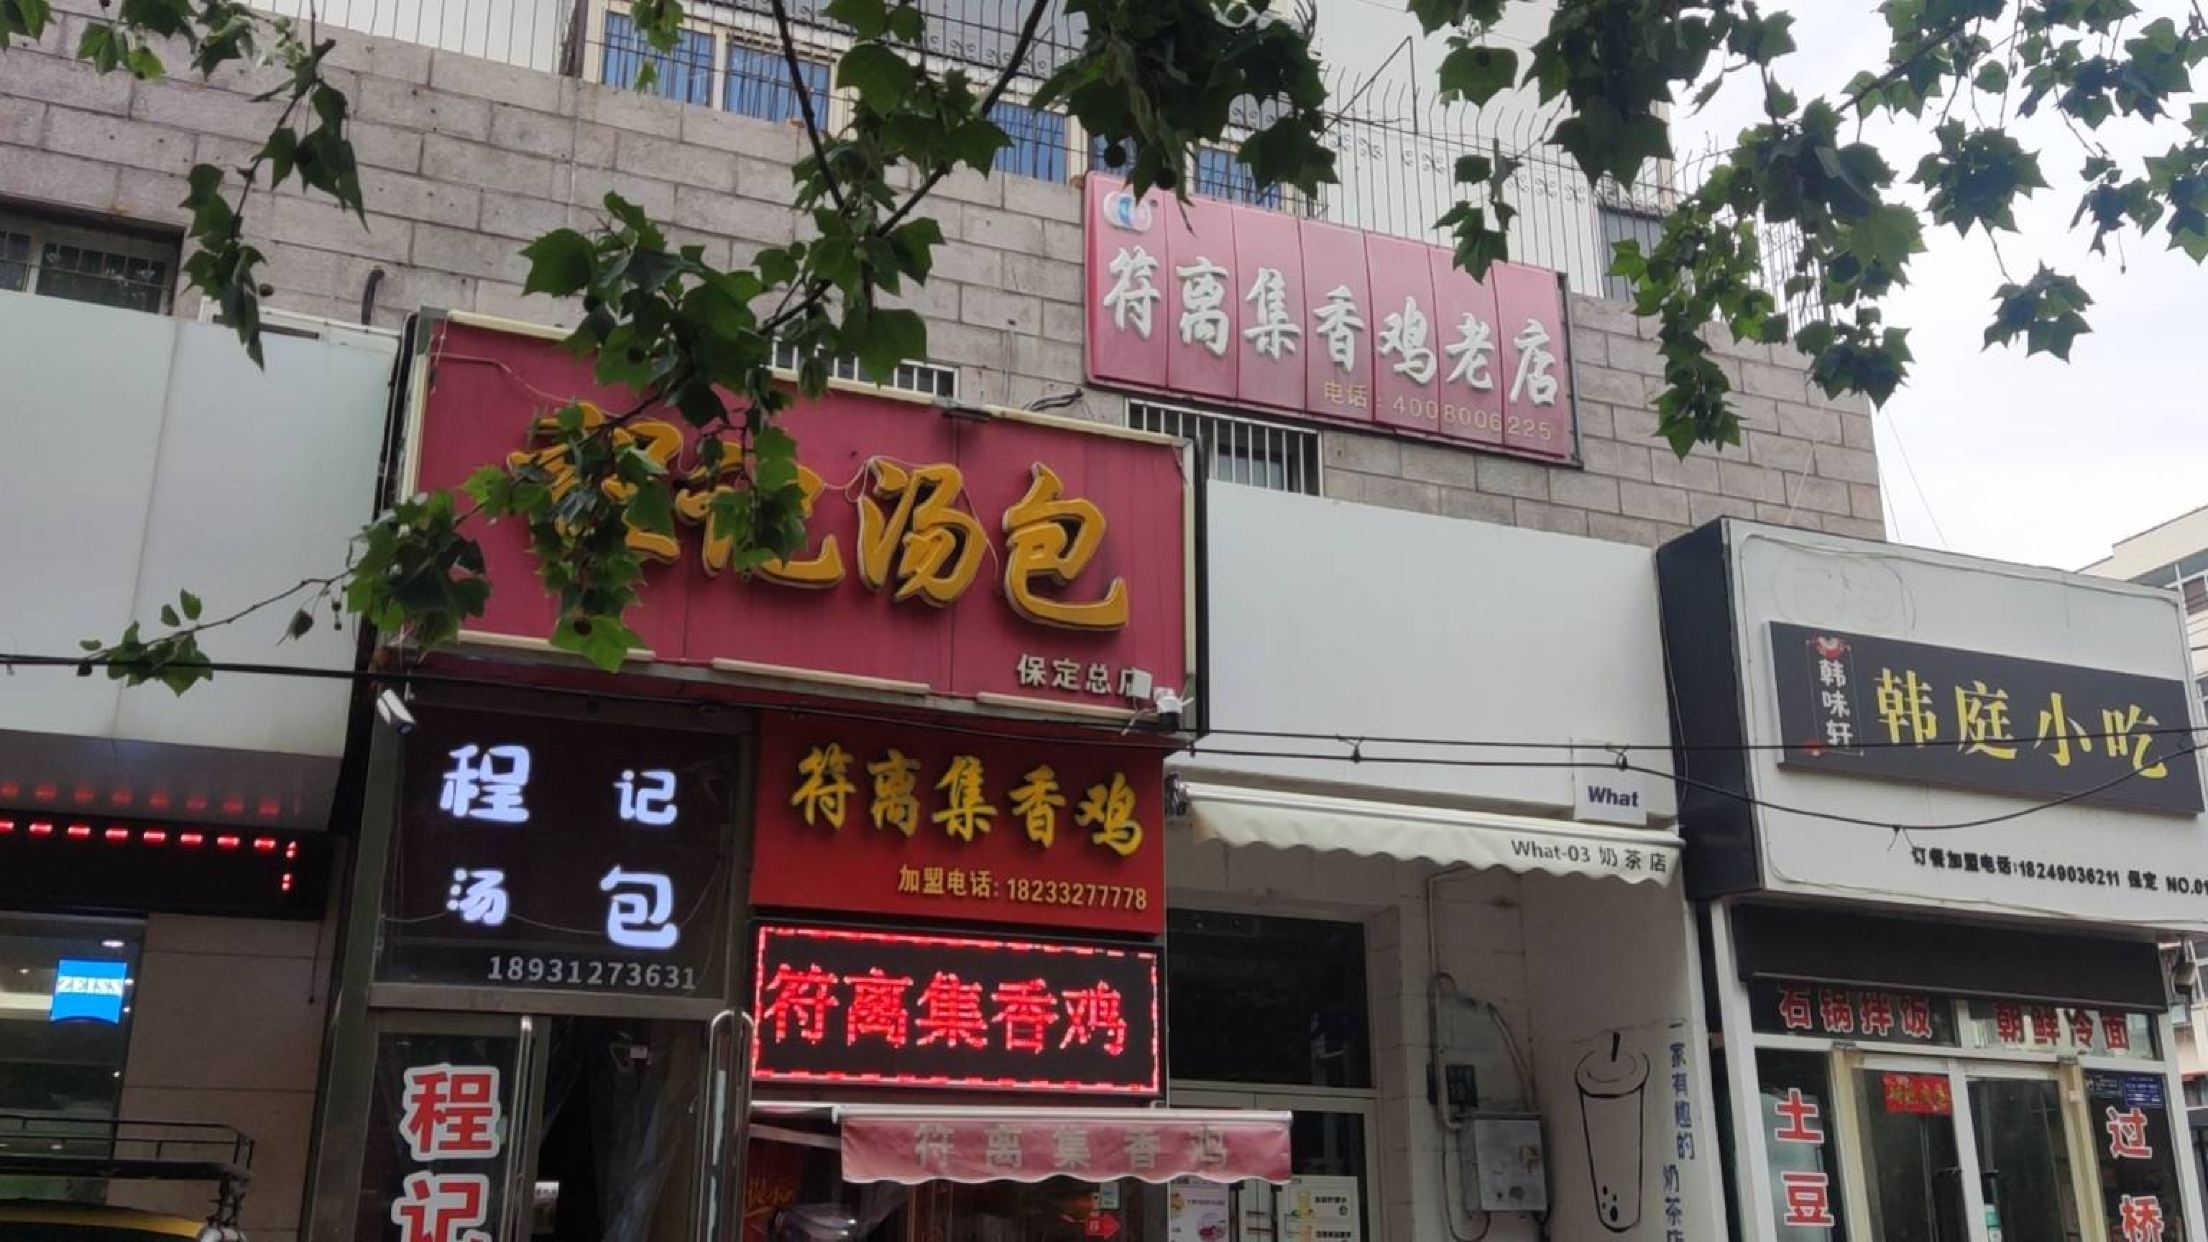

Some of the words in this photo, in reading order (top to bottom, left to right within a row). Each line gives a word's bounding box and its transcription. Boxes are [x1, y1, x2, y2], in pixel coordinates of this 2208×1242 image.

[1103, 245, 1560, 406] 符离集香鸡老店
[1818, 659, 1854, 747] 韩味轩
[1874, 667, 2168, 779] 韩庭小吃
[791, 742, 1144, 857] 符离集香鸡
[1587, 785, 1640, 808] What
[1511, 839, 1591, 864] What-03
[1598, 846, 1667, 874] 奶茶店
[57, 975, 124, 996] ZEISS
[487, 955, 697, 991] 18931273631
[764, 963, 1128, 1057] 符离集香鸡
[1779, 988, 1933, 1039] 石锅拌饭
[1996, 1002, 2130, 1051] 朝鲜冷面
[391, 1063, 499, 1242] 程记
[1774, 1087, 1835, 1227] 土豆
[2105, 1105, 2164, 1242] 过桥
